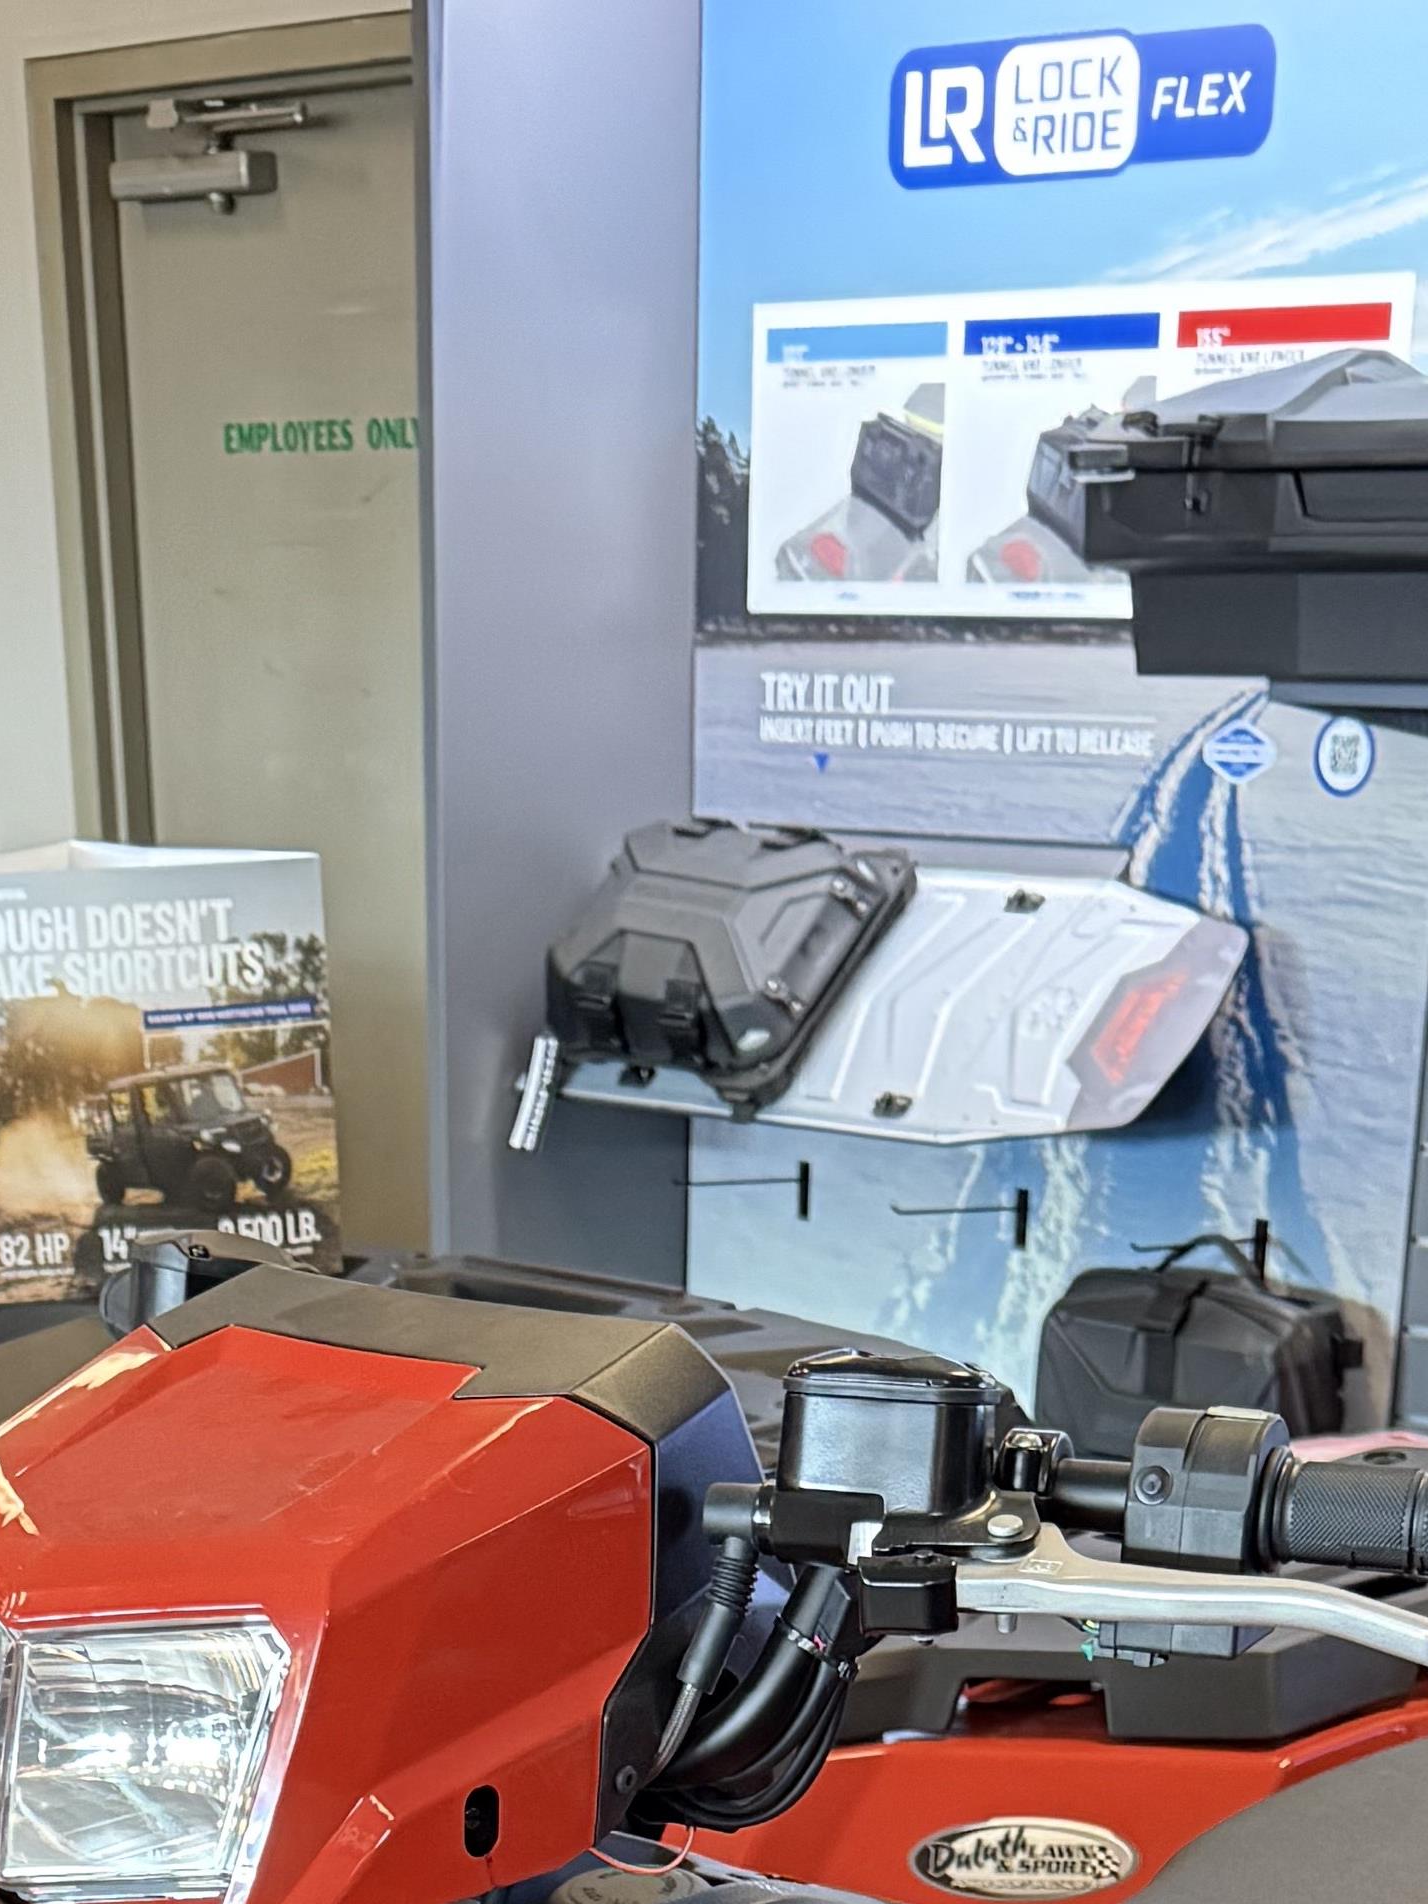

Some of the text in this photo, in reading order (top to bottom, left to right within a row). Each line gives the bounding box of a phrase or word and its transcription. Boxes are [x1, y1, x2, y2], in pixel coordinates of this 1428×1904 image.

[1014, 56, 1124, 106] LOCK
[1151, 70, 1252, 121] FLEX
[903, 65, 984, 167] LR
[1031, 108, 1124, 156] RIDE
[223, 419, 353, 454] EMPLOYEES
[761, 672, 895, 714] TRY IT OUT
[816, 718, 855, 745] FEET
[915, 722, 935, 749] TO
[1056, 727, 1077, 755] TO
[85, 898, 233, 949] DOESN'T
[34, 1231, 71, 1266] HP
[928, 1825, 1027, 1876] Duluth
[996, 1860, 1011, 1875] &
[1028, 1844, 1093, 1859] LAWN
